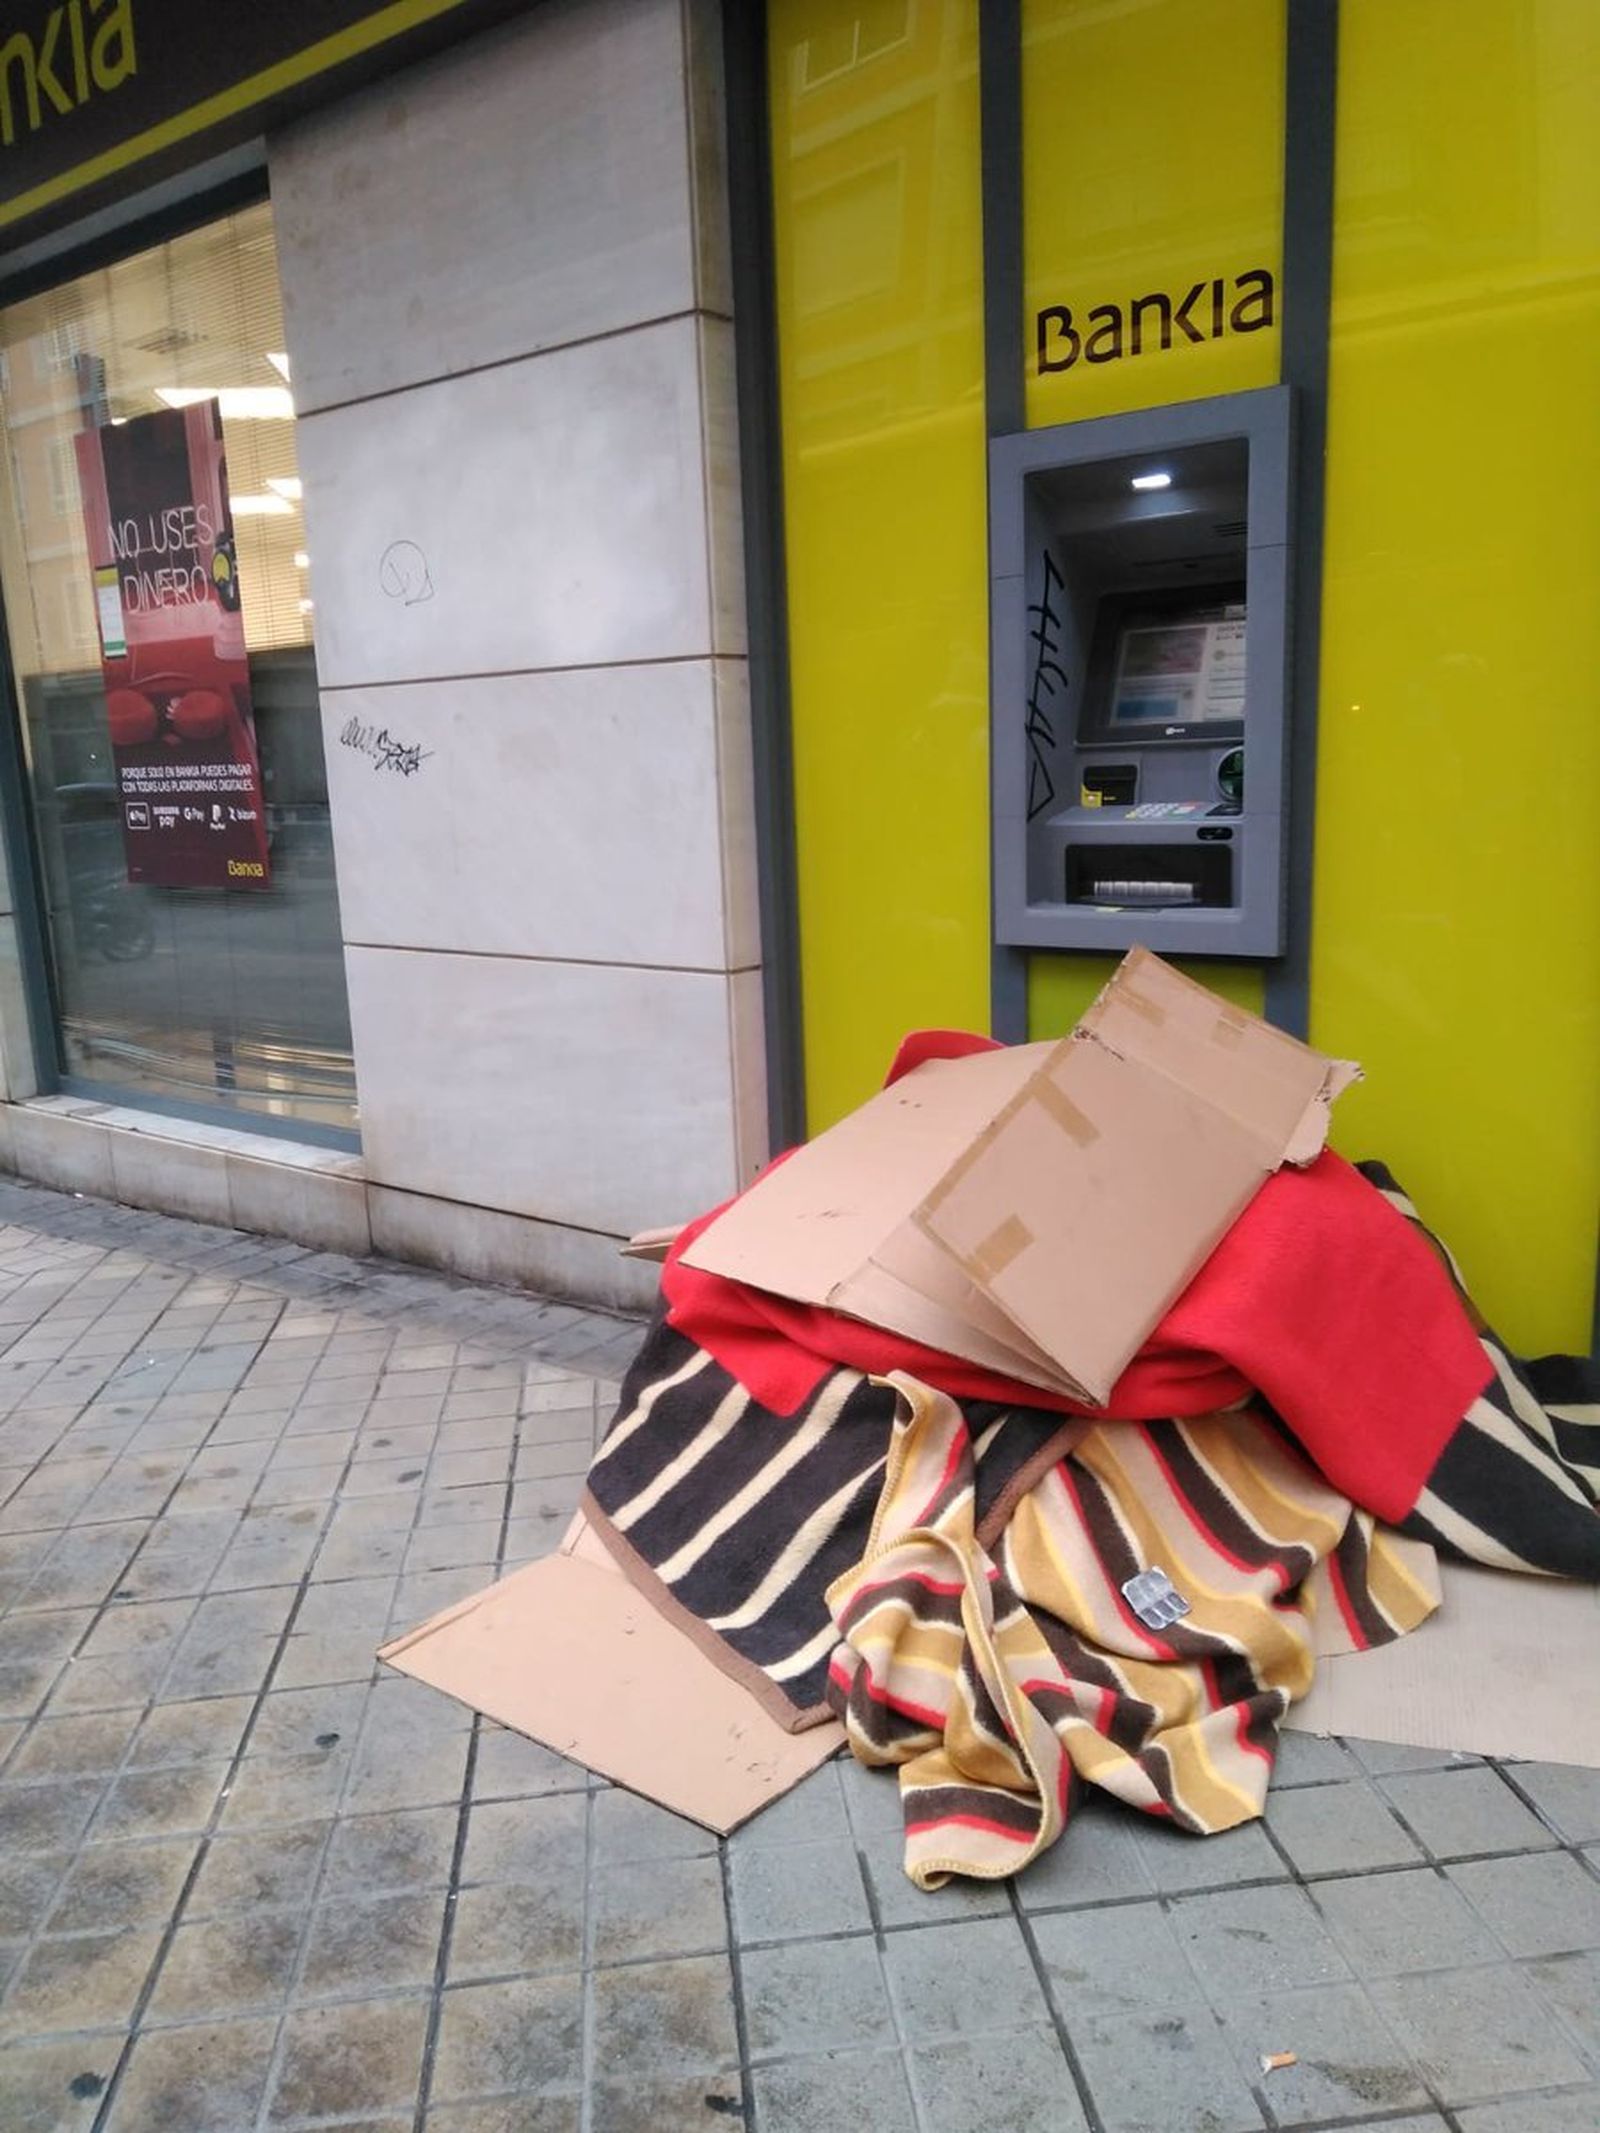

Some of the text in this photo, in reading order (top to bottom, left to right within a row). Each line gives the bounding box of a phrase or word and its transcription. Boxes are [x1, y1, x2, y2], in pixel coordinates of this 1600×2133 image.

[1037, 269, 1273, 376] Bankia
[107, 504, 214, 559] NO USES
[124, 566, 208, 614] DINERO
[122, 767, 146, 780] PORQUE
[165, 766, 175, 778] EN
[200, 765, 227, 777] PUEDES
[228, 763, 251, 776] PAGAR
[122, 781, 136, 792] CON
[171, 779, 218, 792] PLATAFORMAS
